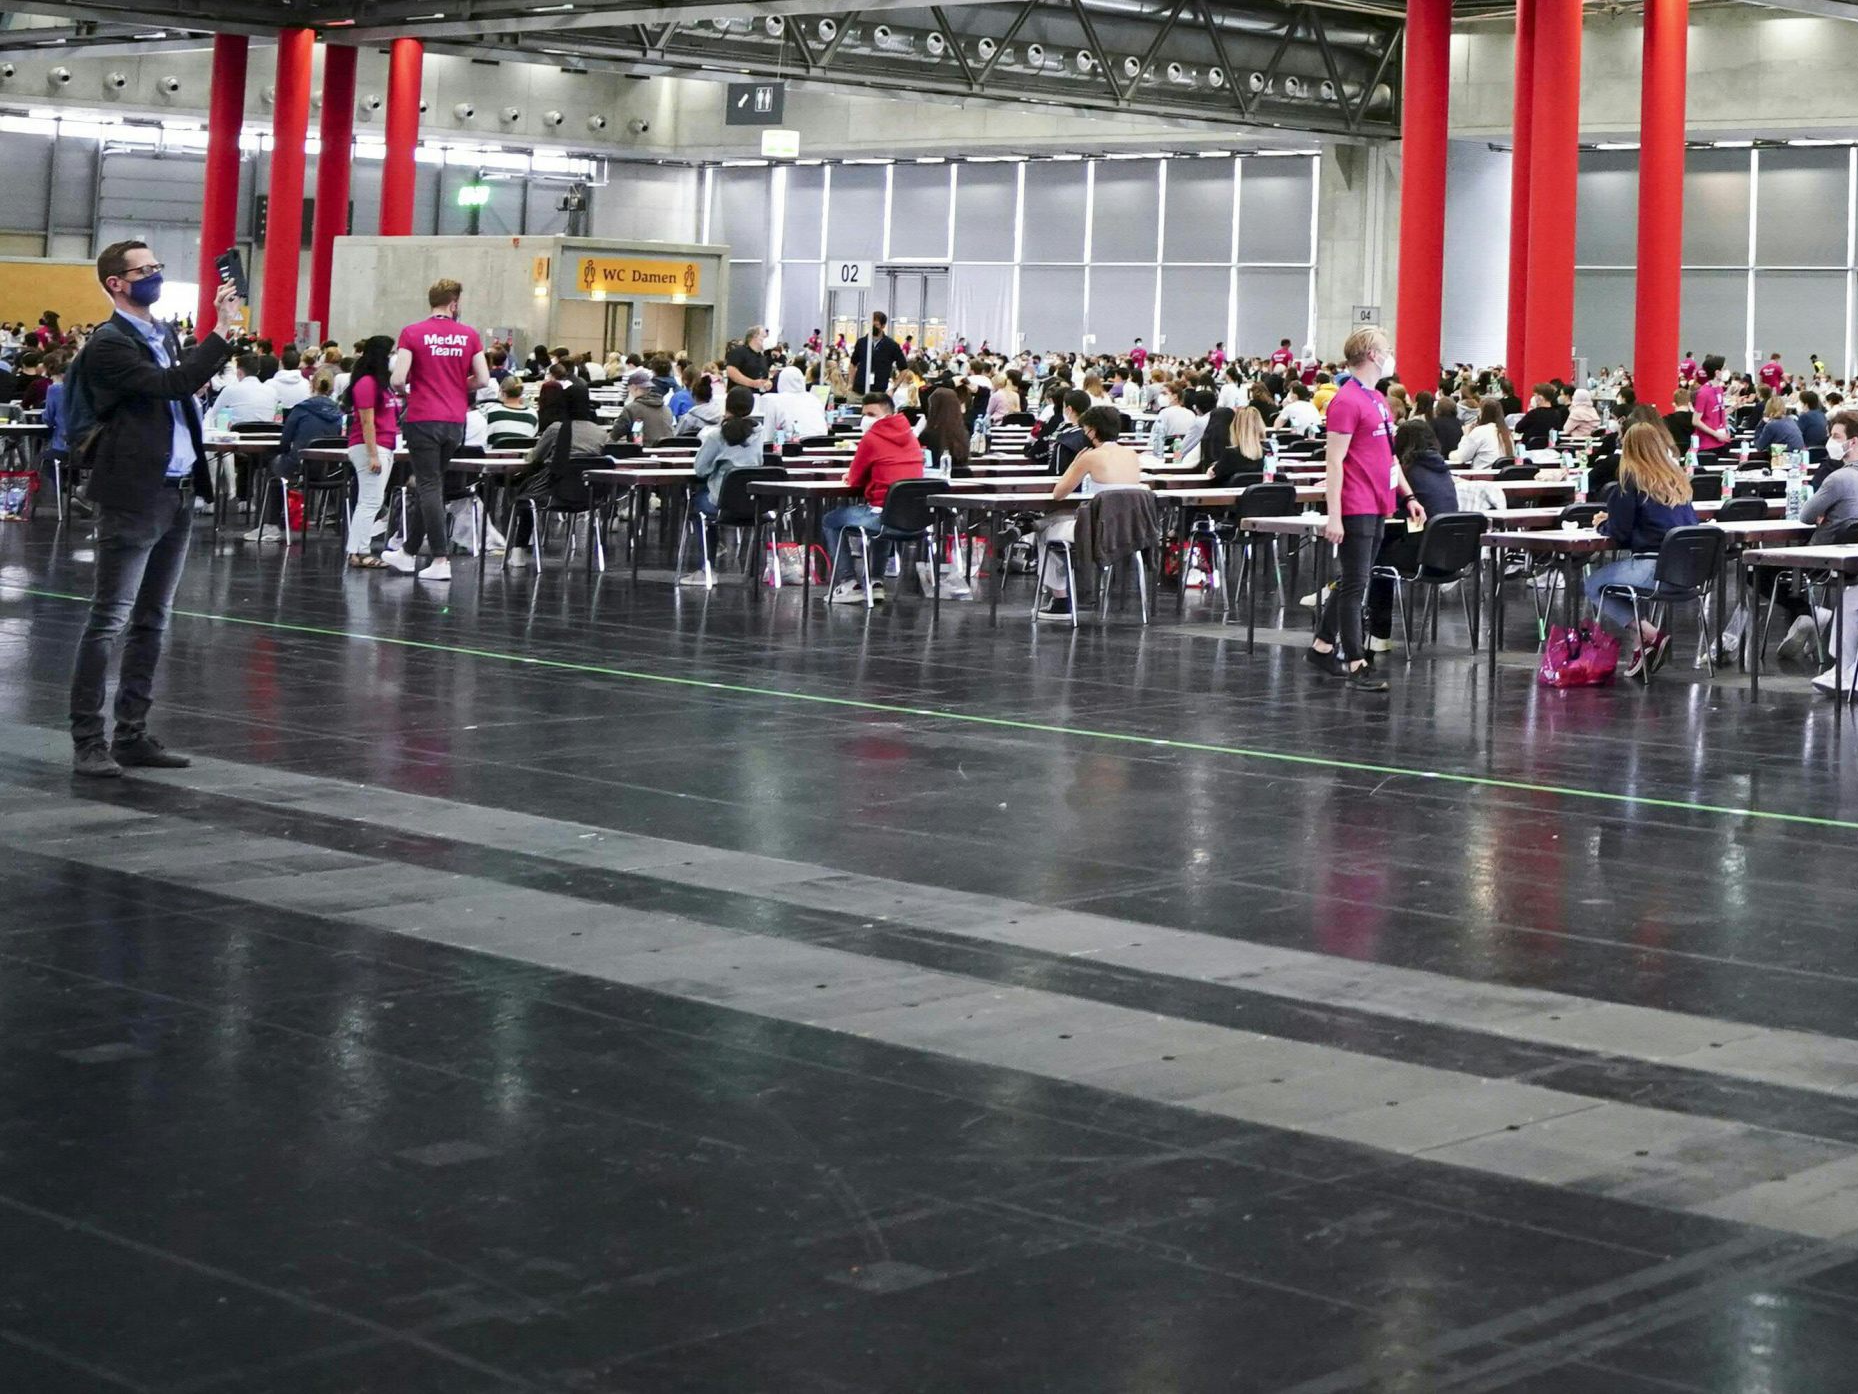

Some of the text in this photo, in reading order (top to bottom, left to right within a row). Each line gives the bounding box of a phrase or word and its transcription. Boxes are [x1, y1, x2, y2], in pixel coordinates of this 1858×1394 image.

[603, 268, 677, 284] WC Damen
[841, 264, 859, 282] 02
[1360, 310, 1372, 321] 04
[423, 333, 469, 347] MedAT
[429, 344, 463, 357] Team
